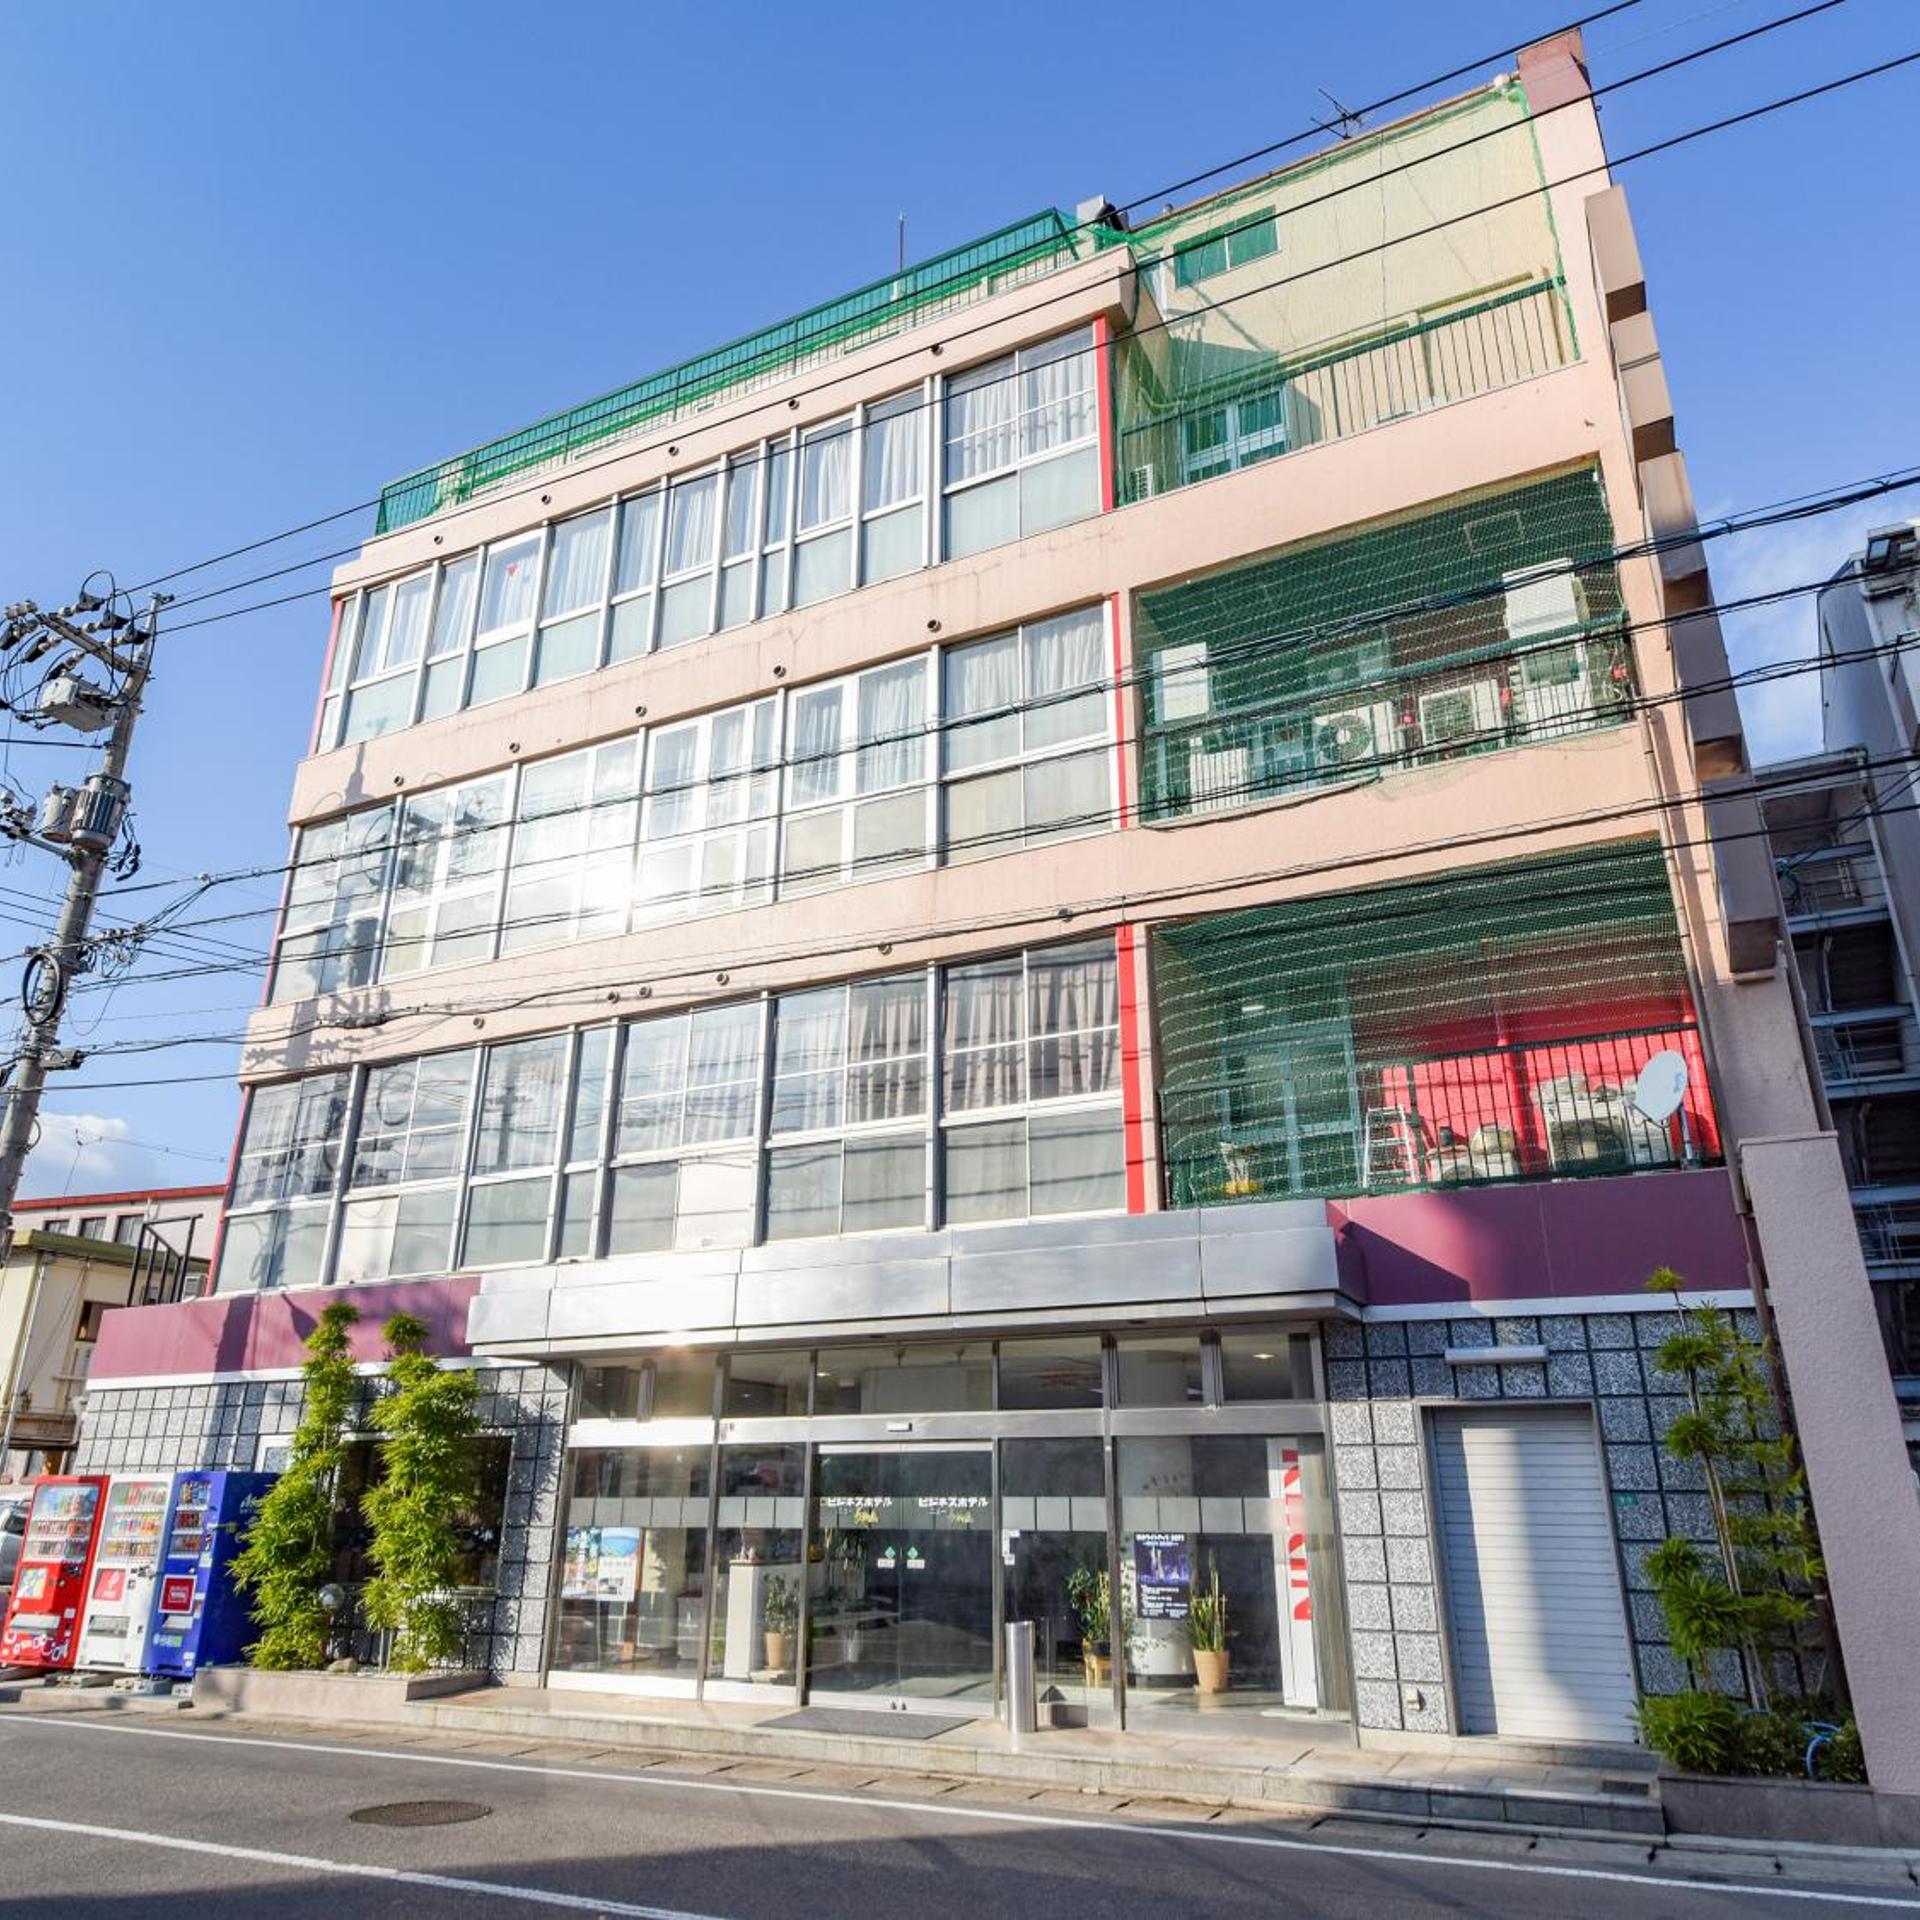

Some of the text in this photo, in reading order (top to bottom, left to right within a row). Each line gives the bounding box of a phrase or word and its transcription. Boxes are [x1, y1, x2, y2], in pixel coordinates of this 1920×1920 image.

[827, 1496, 893, 1508] ビジネスホテル
[918, 1496, 989, 1508] ビジネスホテル
